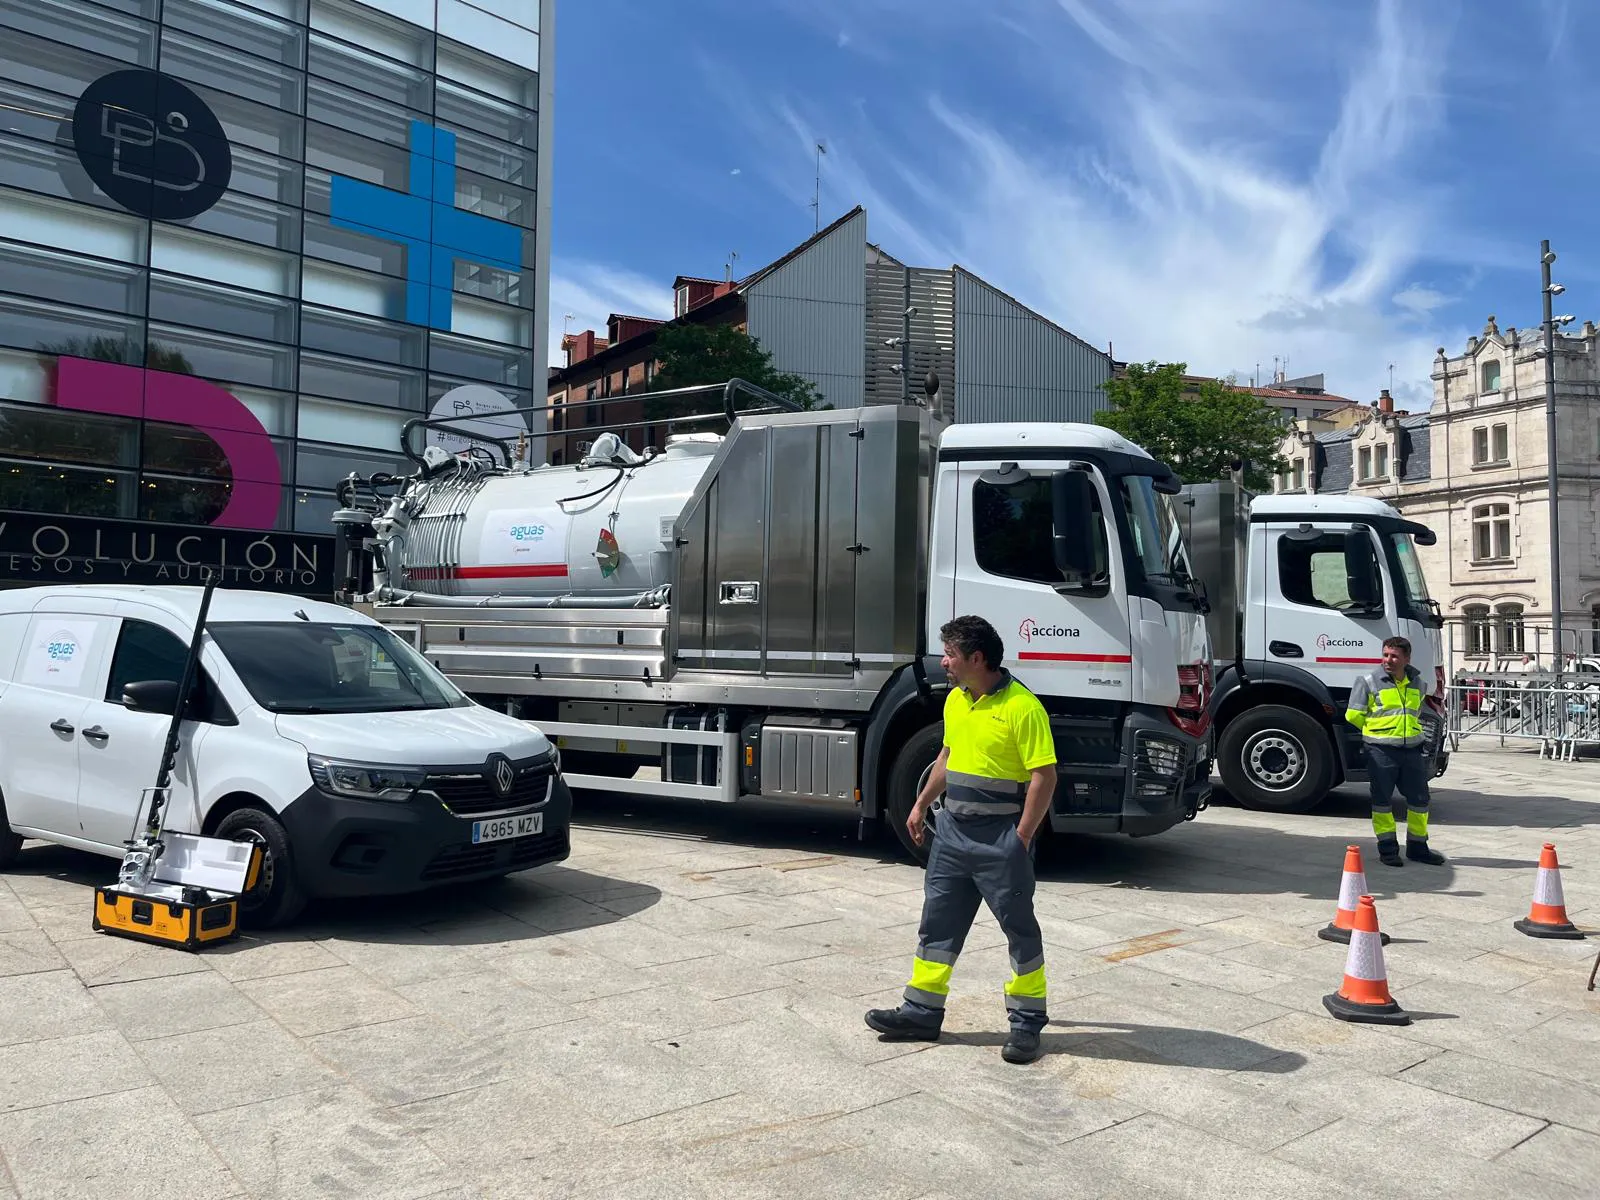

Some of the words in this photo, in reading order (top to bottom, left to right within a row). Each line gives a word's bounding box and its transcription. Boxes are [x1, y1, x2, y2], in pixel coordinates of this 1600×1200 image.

[510, 525, 545, 540] aguas
[0, 521, 317, 571] OLUCIÓN
[120, 561, 133, 577] Y
[156, 564, 317, 586] AUDITORIO
[1032, 625, 1080, 637] acciona
[47, 642, 75, 659] aguas
[1326, 637, 1363, 647] acciona
[482, 820, 514, 839] 4965
[517, 815, 540, 834] MZV
